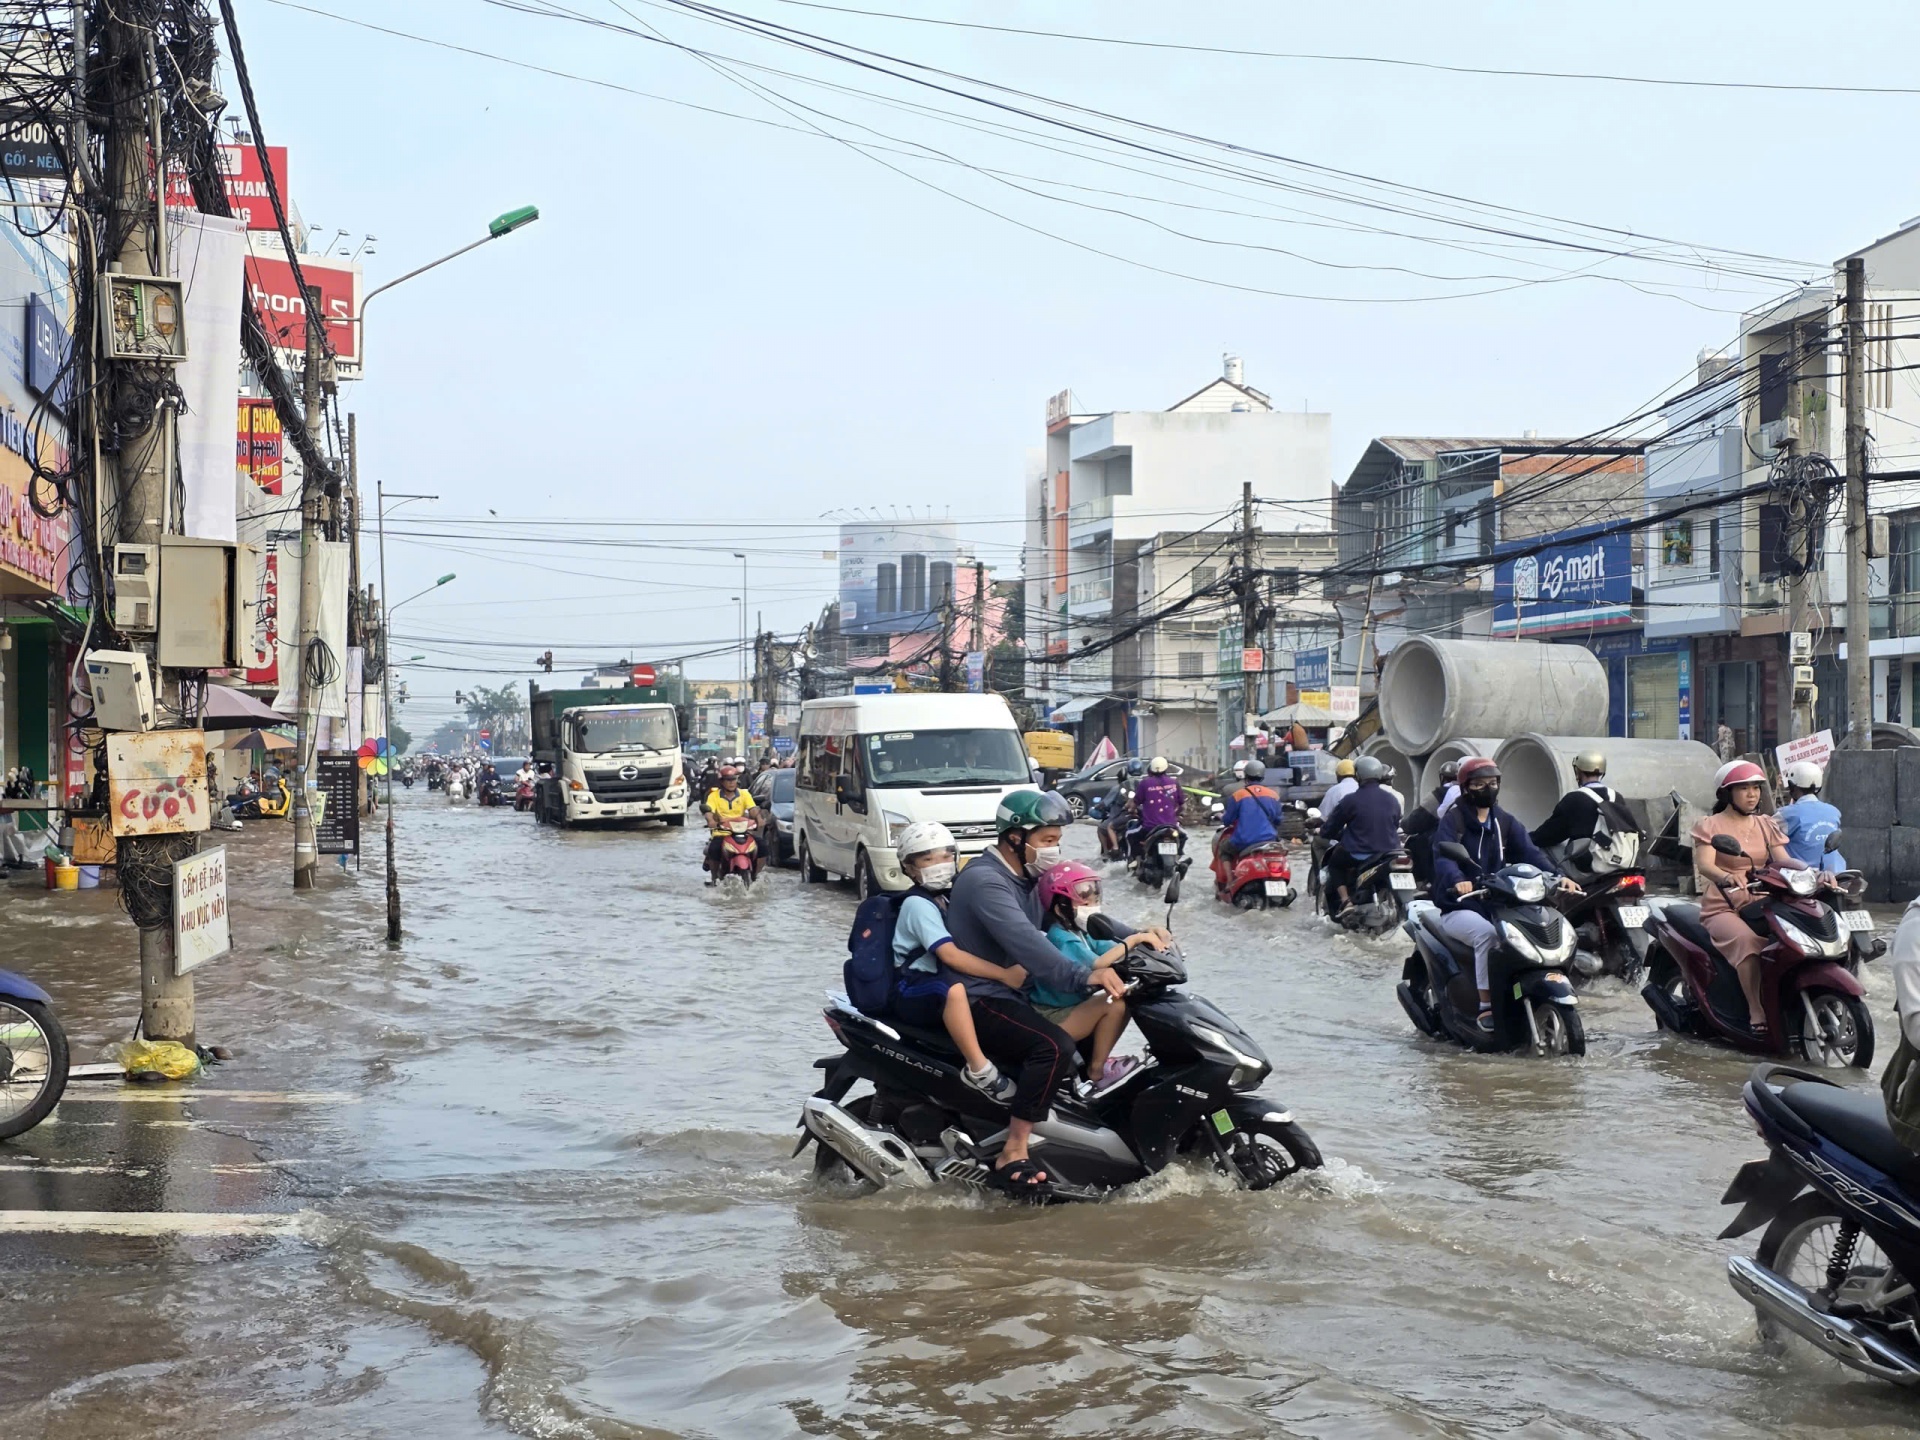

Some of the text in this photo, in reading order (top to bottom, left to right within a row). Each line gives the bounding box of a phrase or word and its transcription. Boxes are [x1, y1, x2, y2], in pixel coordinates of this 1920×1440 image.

[182, 866, 199, 899] CẤM
[181, 893, 225, 933] KHU VỰC NÀY
[872, 1044, 943, 1077] AIRBLADE
[1176, 1084, 1209, 1099] 125
